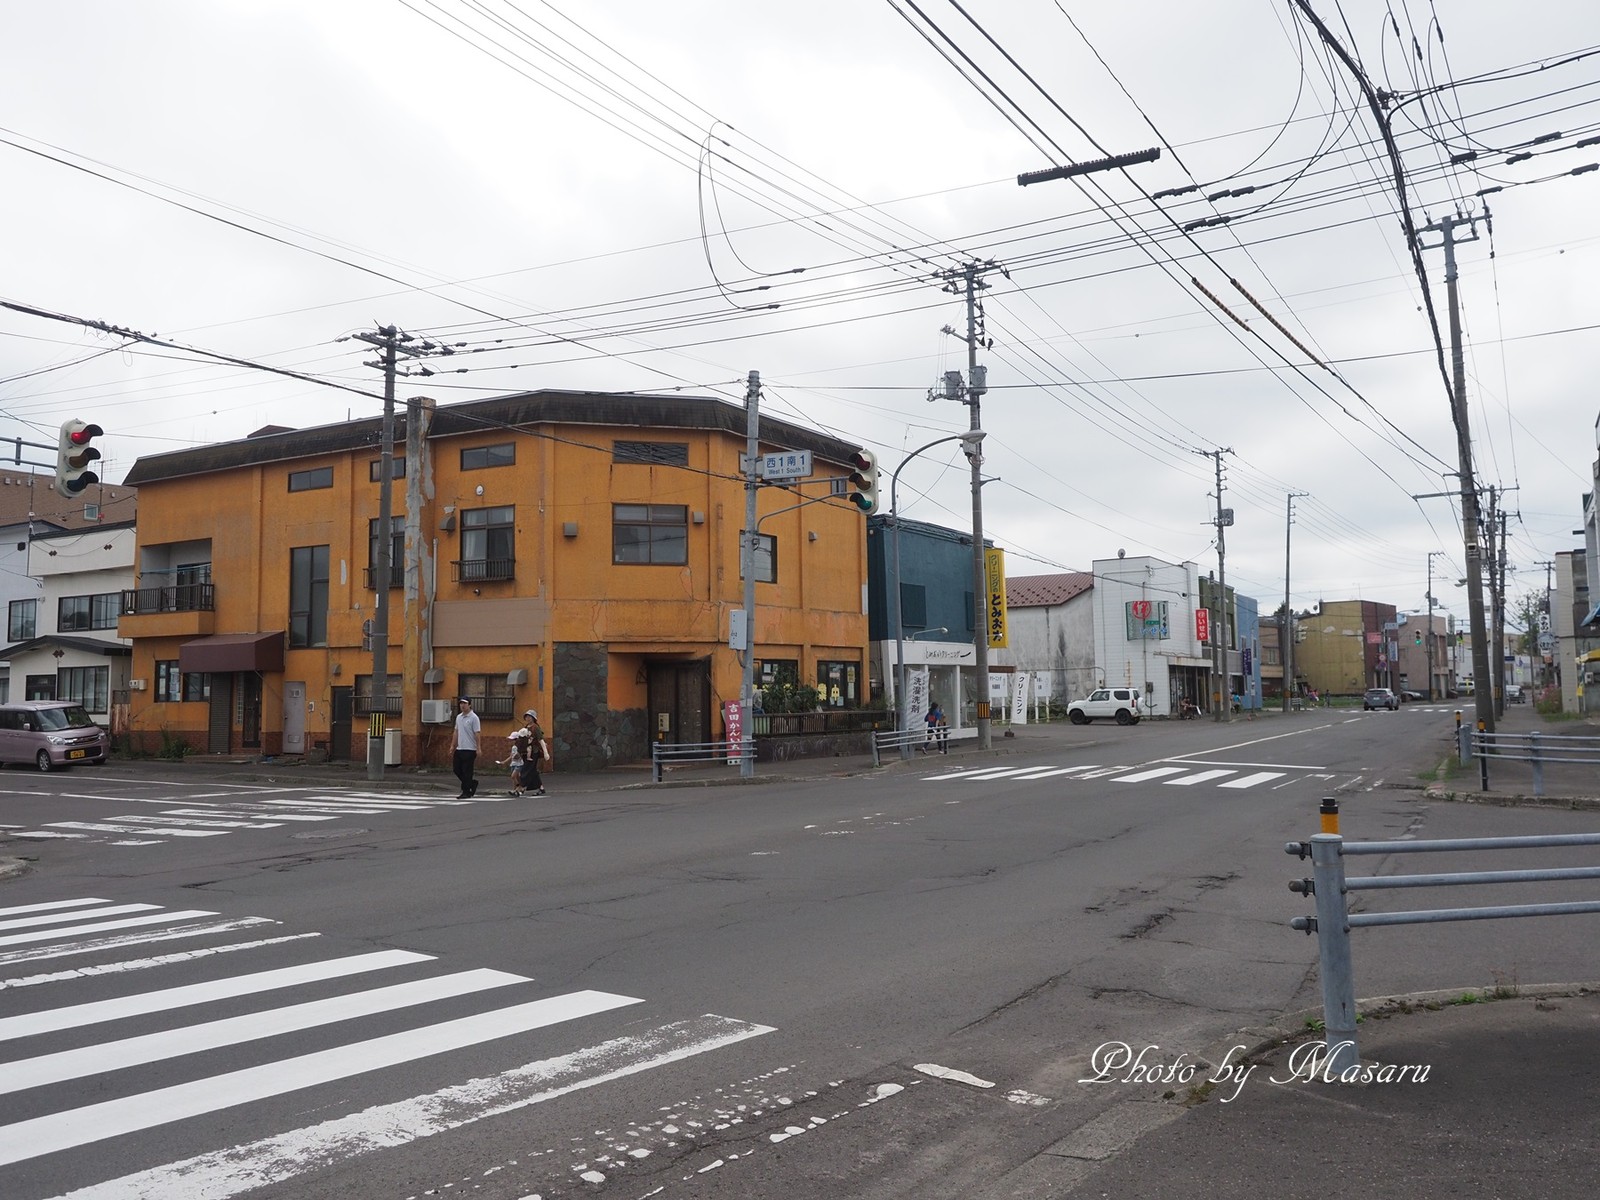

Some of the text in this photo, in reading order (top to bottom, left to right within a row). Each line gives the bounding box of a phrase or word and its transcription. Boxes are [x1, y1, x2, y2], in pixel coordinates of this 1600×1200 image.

[1198, 619, 1206, 638] いせや
[911, 676, 921, 713] 洗濯洗剤
[1016, 676, 1025, 715] クリーニング
